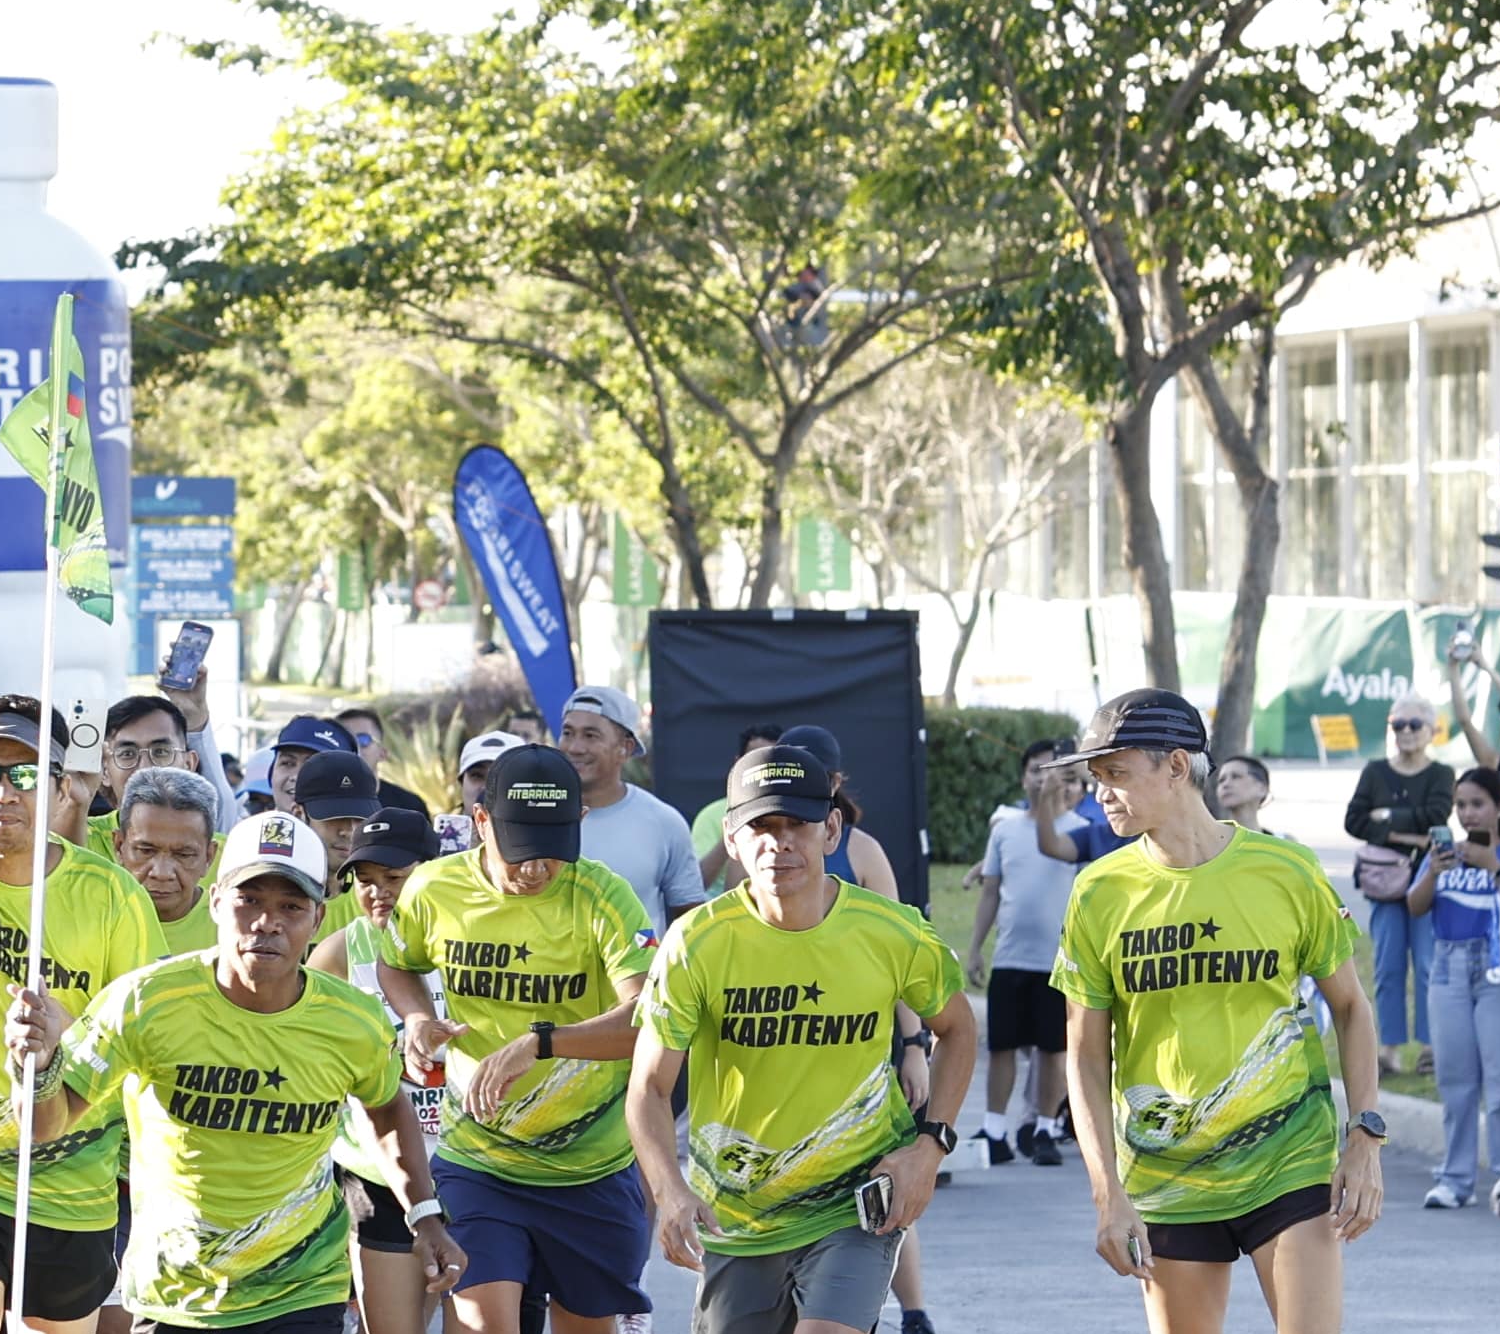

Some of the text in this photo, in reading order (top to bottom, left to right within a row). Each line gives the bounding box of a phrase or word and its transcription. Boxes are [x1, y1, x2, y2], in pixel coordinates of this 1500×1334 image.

[509, 560, 560, 634] SWEAT
[507, 788, 568, 800] FITBARKADA
[443, 938, 511, 969] TAKBO
[1119, 922, 1196, 959] TAKBO
[445, 965, 588, 1005] KABITENYO
[1121, 948, 1280, 993] KABITENYO
[722, 984, 799, 1014] TAKBO
[720, 1010, 880, 1048] KABITENYO
[174, 1063, 260, 1095] TAKBO
[167, 1088, 340, 1135] KABITENYO
